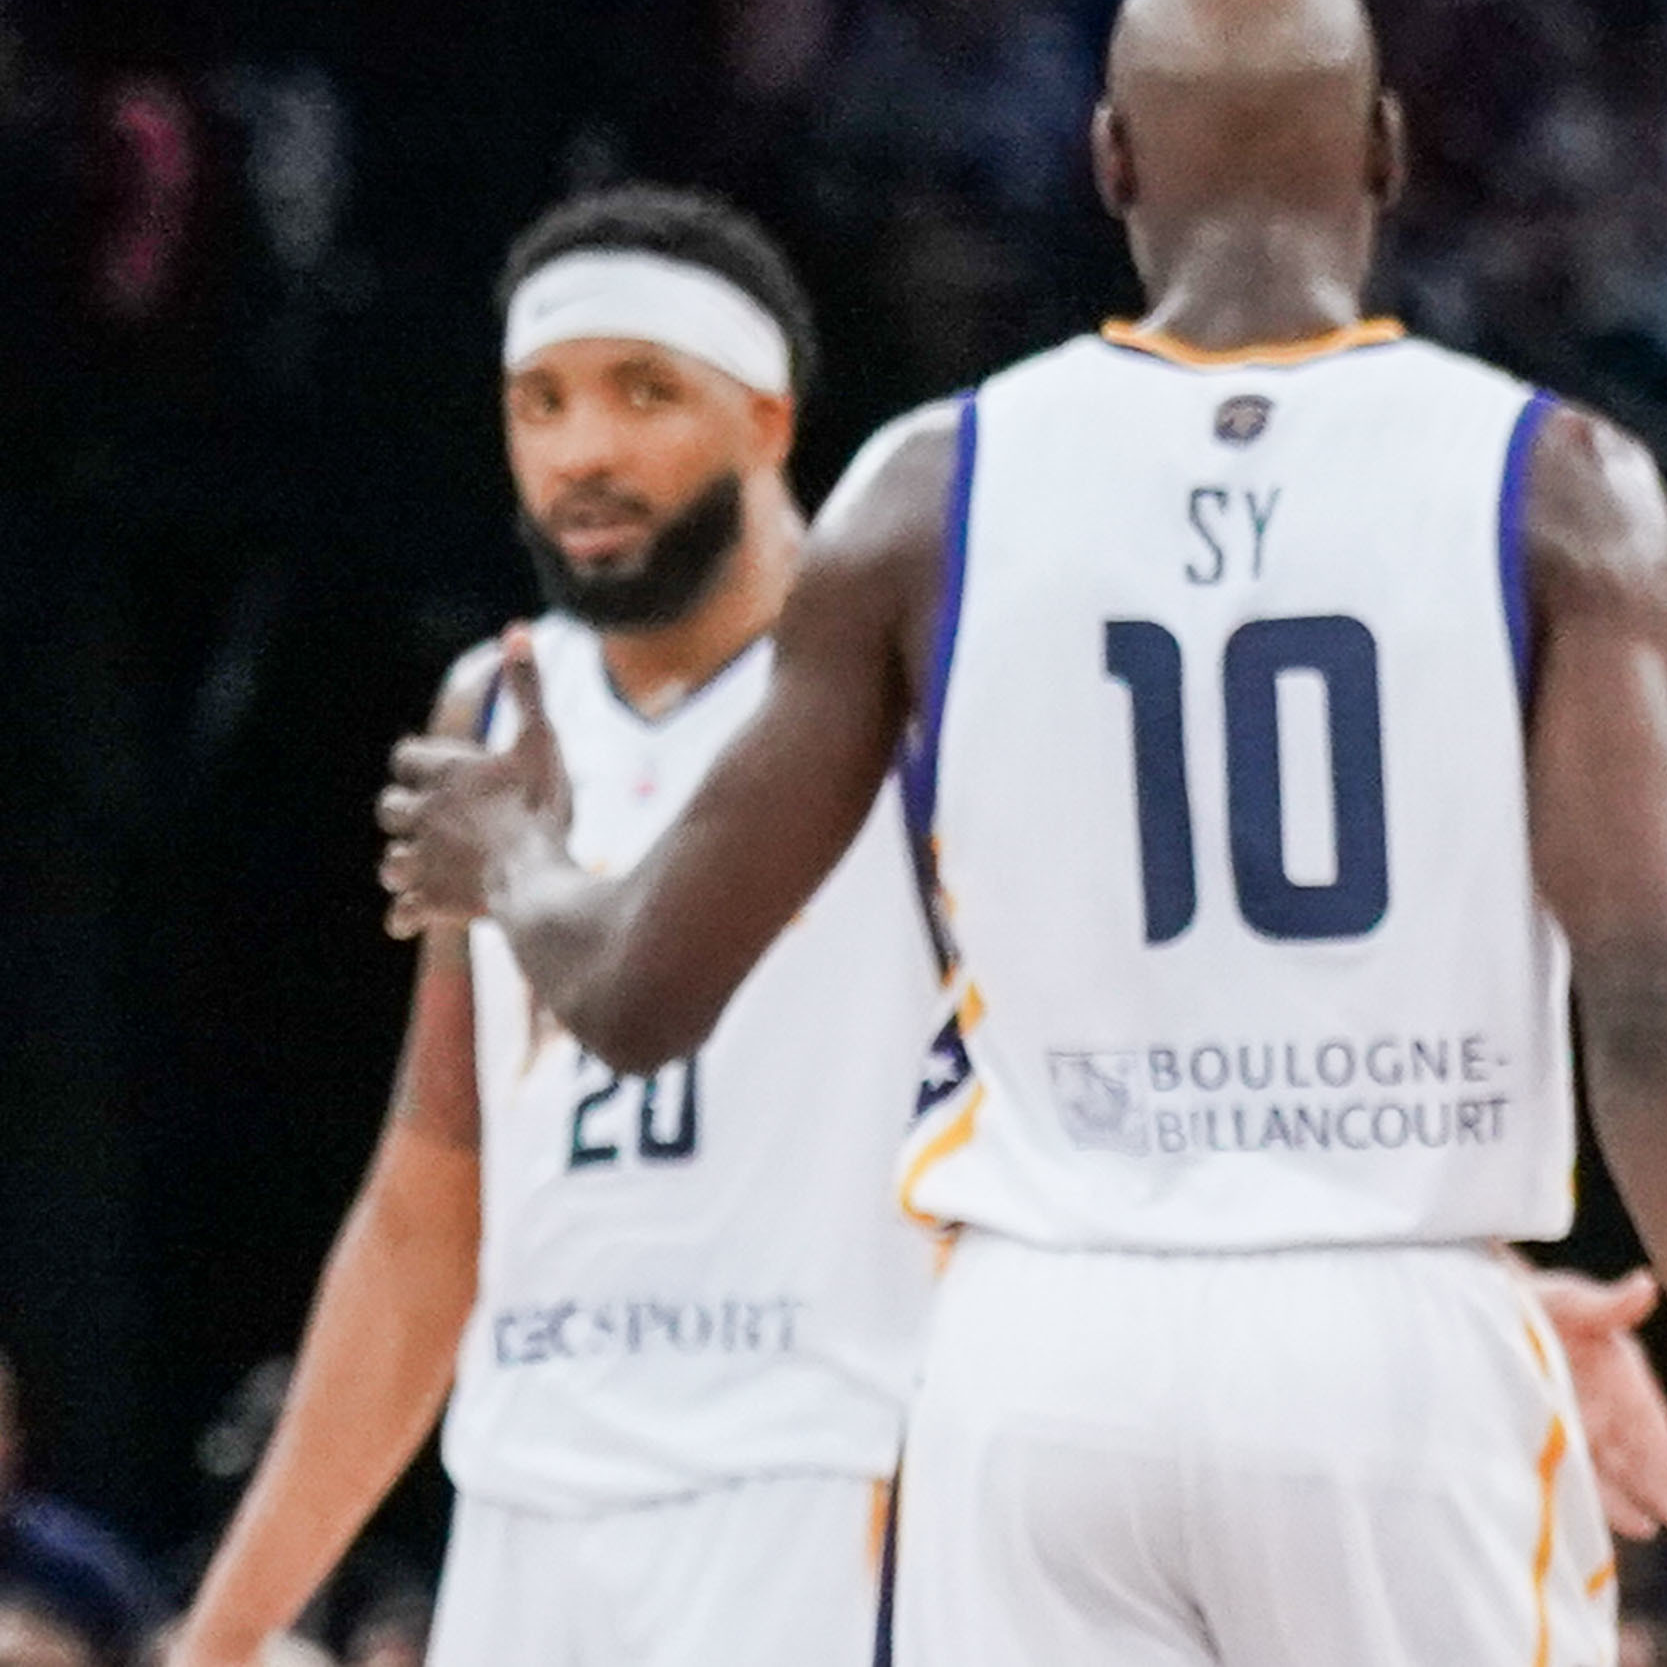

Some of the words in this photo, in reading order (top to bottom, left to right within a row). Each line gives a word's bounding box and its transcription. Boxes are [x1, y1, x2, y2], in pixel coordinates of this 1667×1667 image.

[1185, 487, 1281, 587] SY
[1104, 615, 1390, 946] 10
[1155, 1097, 1509, 1153] BILLANCOURT
